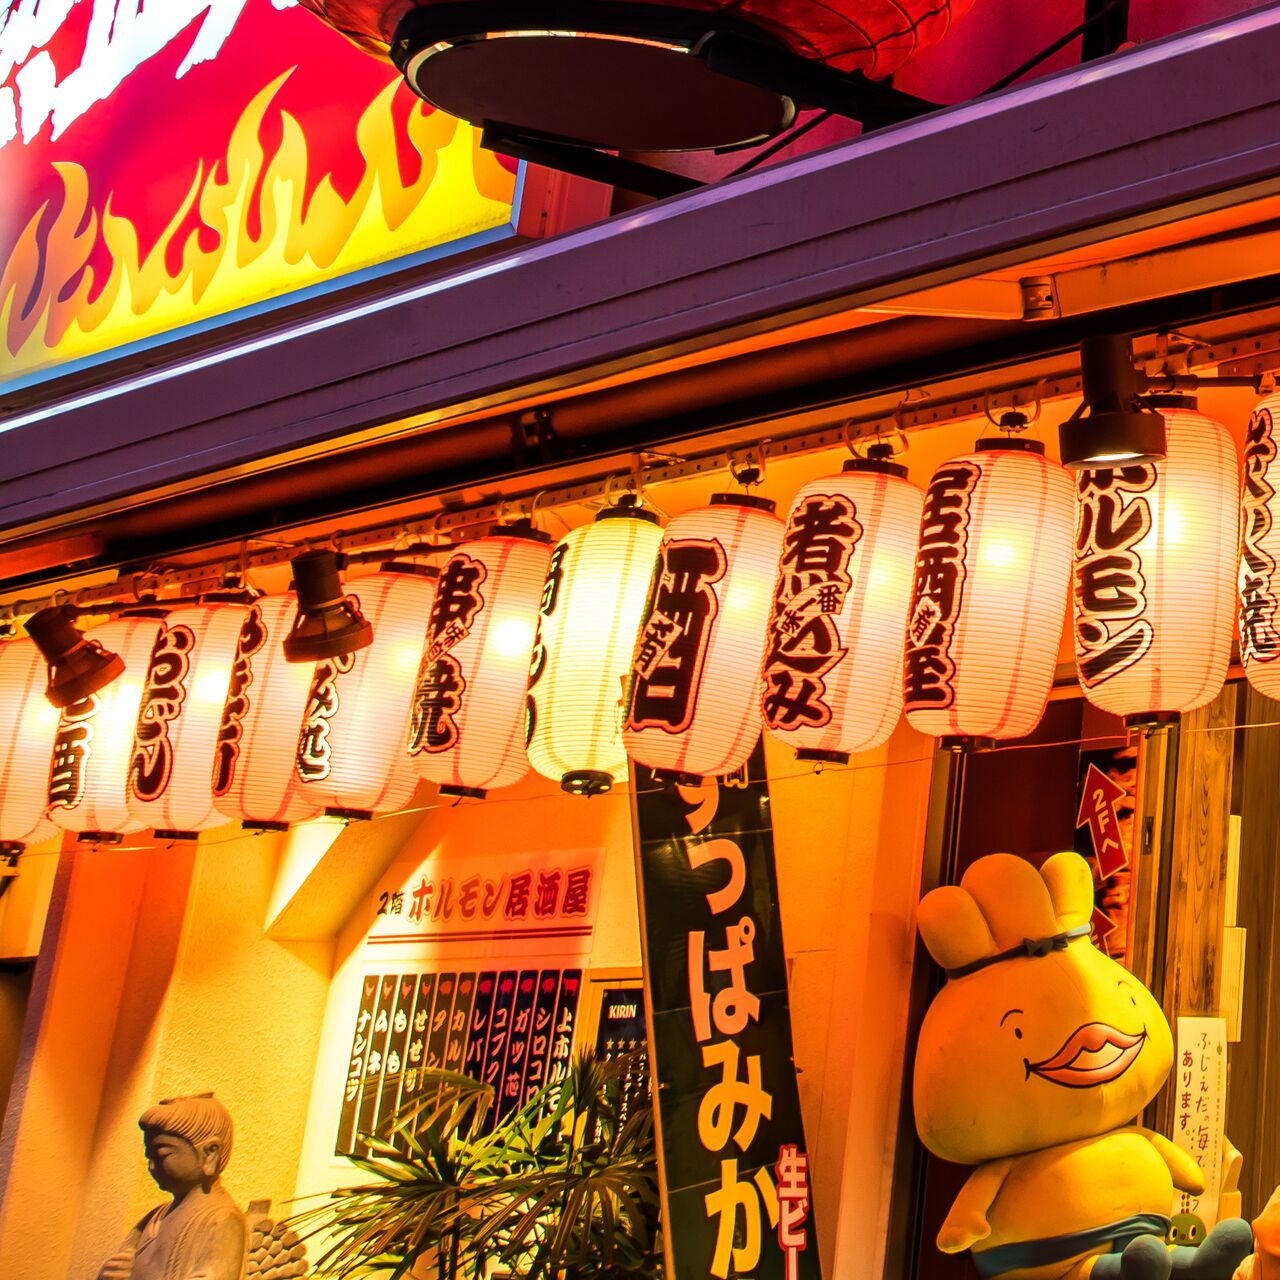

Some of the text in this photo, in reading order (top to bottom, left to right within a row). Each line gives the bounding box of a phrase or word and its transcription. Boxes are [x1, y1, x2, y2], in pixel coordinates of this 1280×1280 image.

[408, 868, 594, 922] ホルモン居酒屋
[387, 1009, 408, 1074] もも
[608, 1004, 637, 1019] KIRIN
[467, 1008, 486, 1081] レバ
[547, 1007, 573, 1136] 上ホルモ
